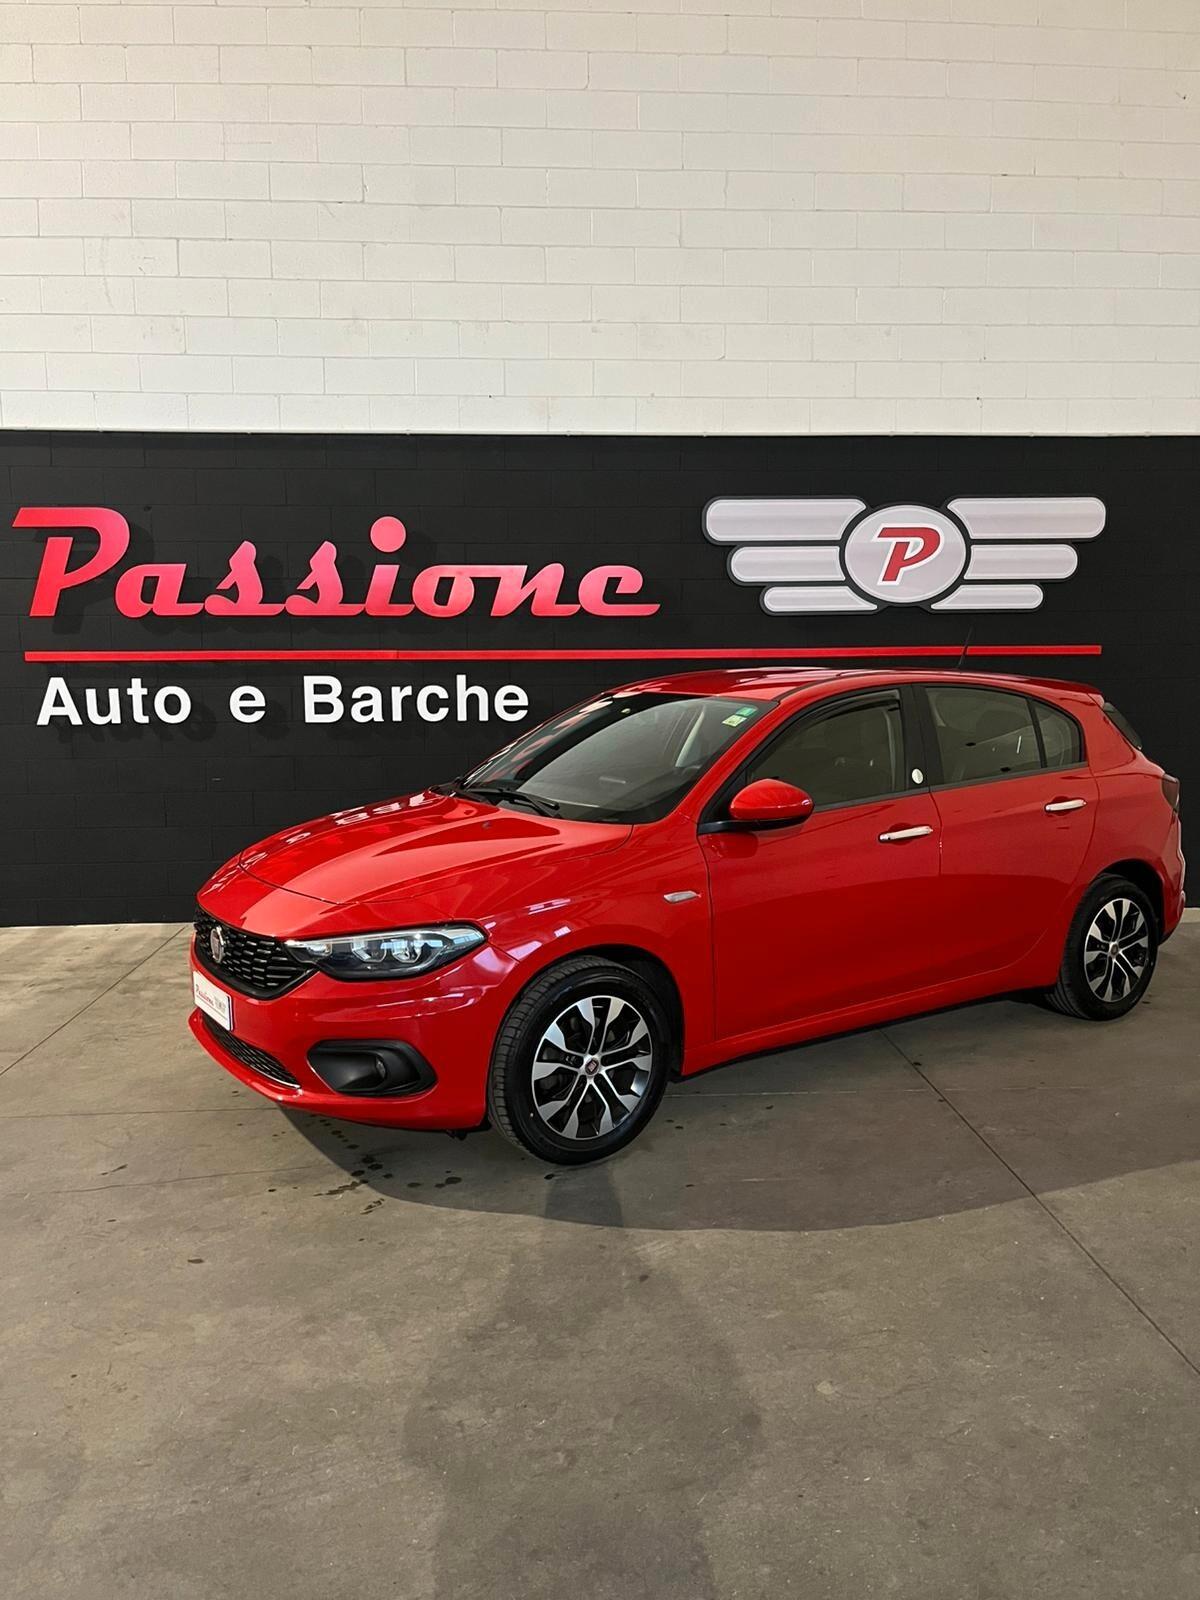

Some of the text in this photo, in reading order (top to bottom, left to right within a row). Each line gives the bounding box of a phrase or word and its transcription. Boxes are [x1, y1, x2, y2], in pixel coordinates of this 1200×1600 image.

[12, 506, 660, 618] Passione
[875, 525, 943, 584] P
[36, 674, 529, 726] Auto e Barche
